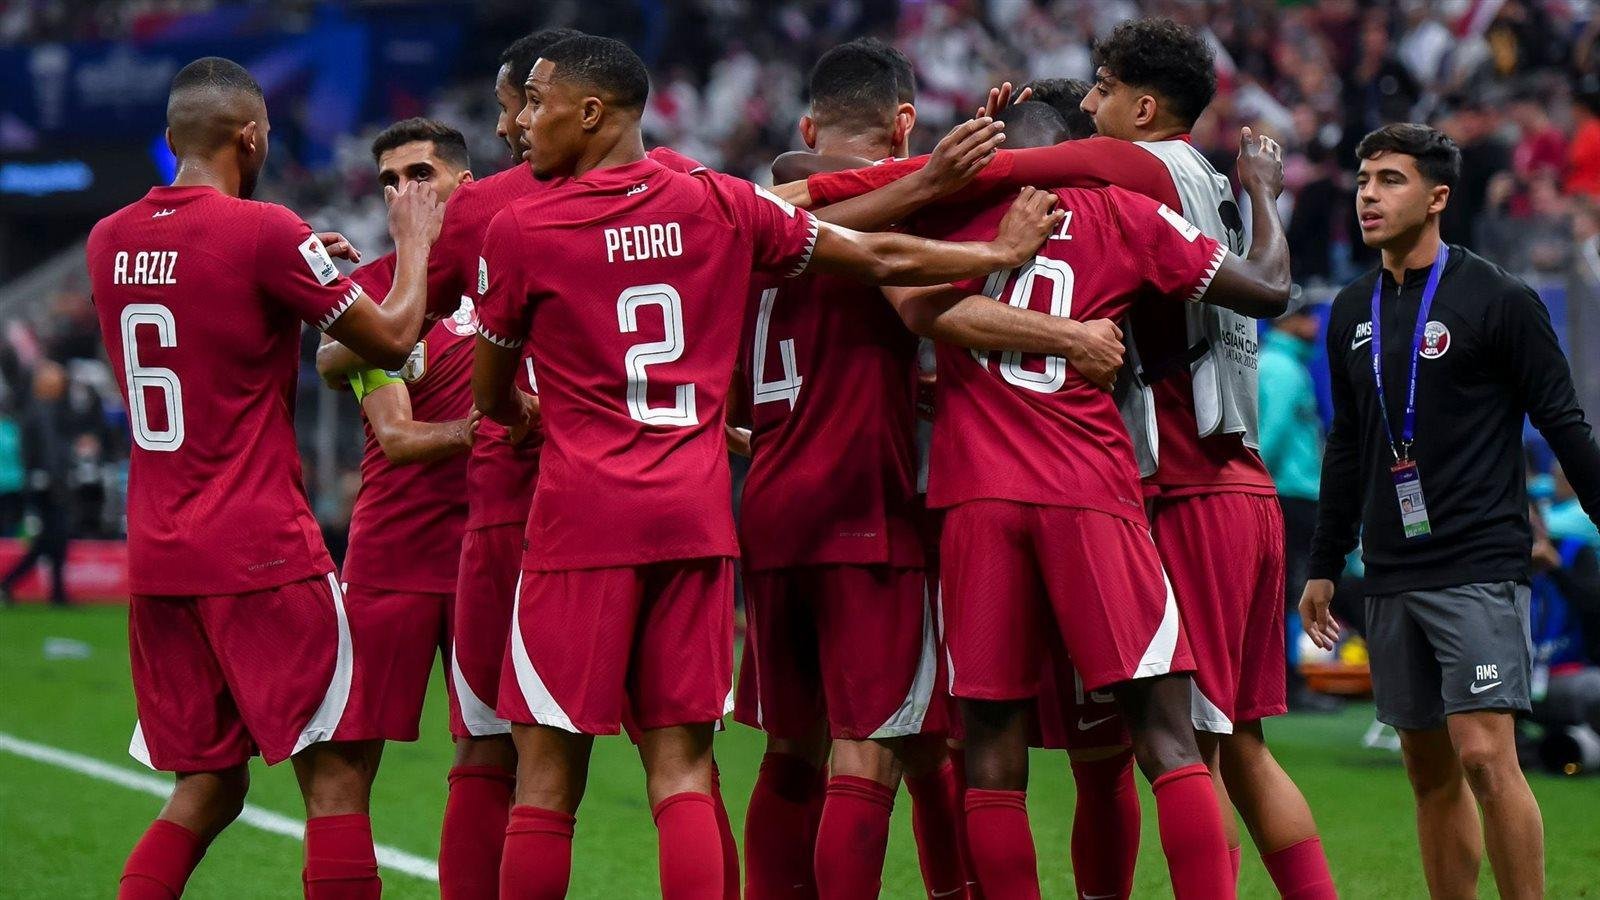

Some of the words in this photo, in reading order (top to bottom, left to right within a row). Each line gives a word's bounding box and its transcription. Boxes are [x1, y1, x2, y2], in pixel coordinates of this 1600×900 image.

[604, 222, 683, 262] PEDRO
[113, 251, 178, 285] A.AZIZ
[1235, 322, 1246, 335] AFC
[1355, 321, 1372, 338] AMS
[616, 283, 699, 427] 2
[753, 288, 803, 412] 4
[1425, 347, 1439, 355] QFA
[120, 303, 184, 451] 6
[1475, 663, 1499, 680] AMS
